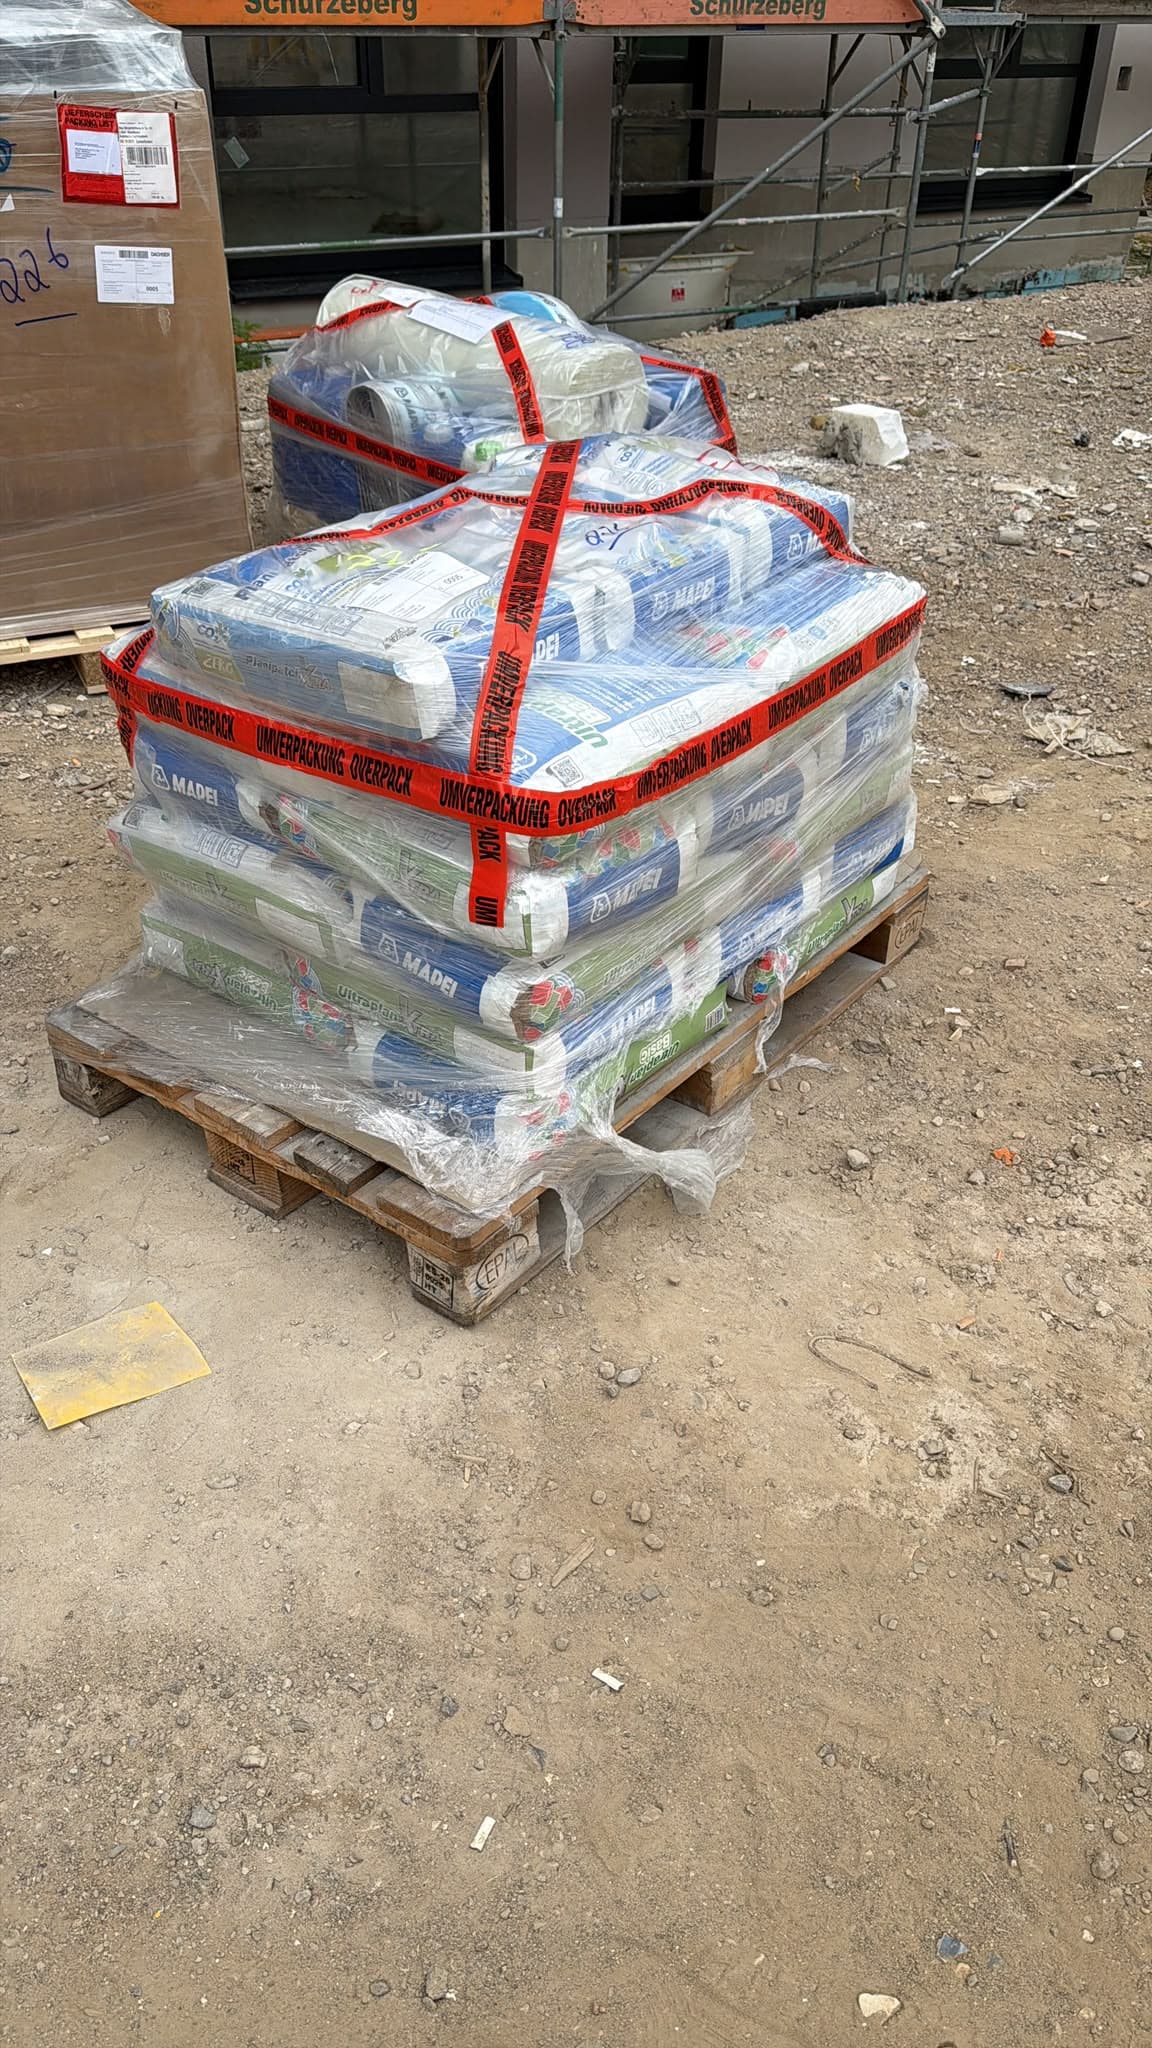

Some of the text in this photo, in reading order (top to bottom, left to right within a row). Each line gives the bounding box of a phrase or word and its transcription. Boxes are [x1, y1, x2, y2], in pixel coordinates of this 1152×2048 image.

[98, 120, 115, 128] LIST
[185, 701, 236, 743] OVERPACK
[256, 724, 345, 777] UMVERPACKUNG
[350, 752, 415, 797] OVERPACK
[439, 777, 550, 829] UMVERPACKUNG
[557, 786, 617, 828] OVERPACK
[637, 745, 707, 799] UMVERPACKUNG
[711, 717, 753, 768] OVERPACK
[768, 671, 826, 731] UMVERPACKUNG
[829, 650, 863, 692] OVERPACK
[337, 983, 401, 1021] Ultraplan
[629, 1041, 680, 1083] Ultraplan
[641, 1032, 671, 1063] Basic
